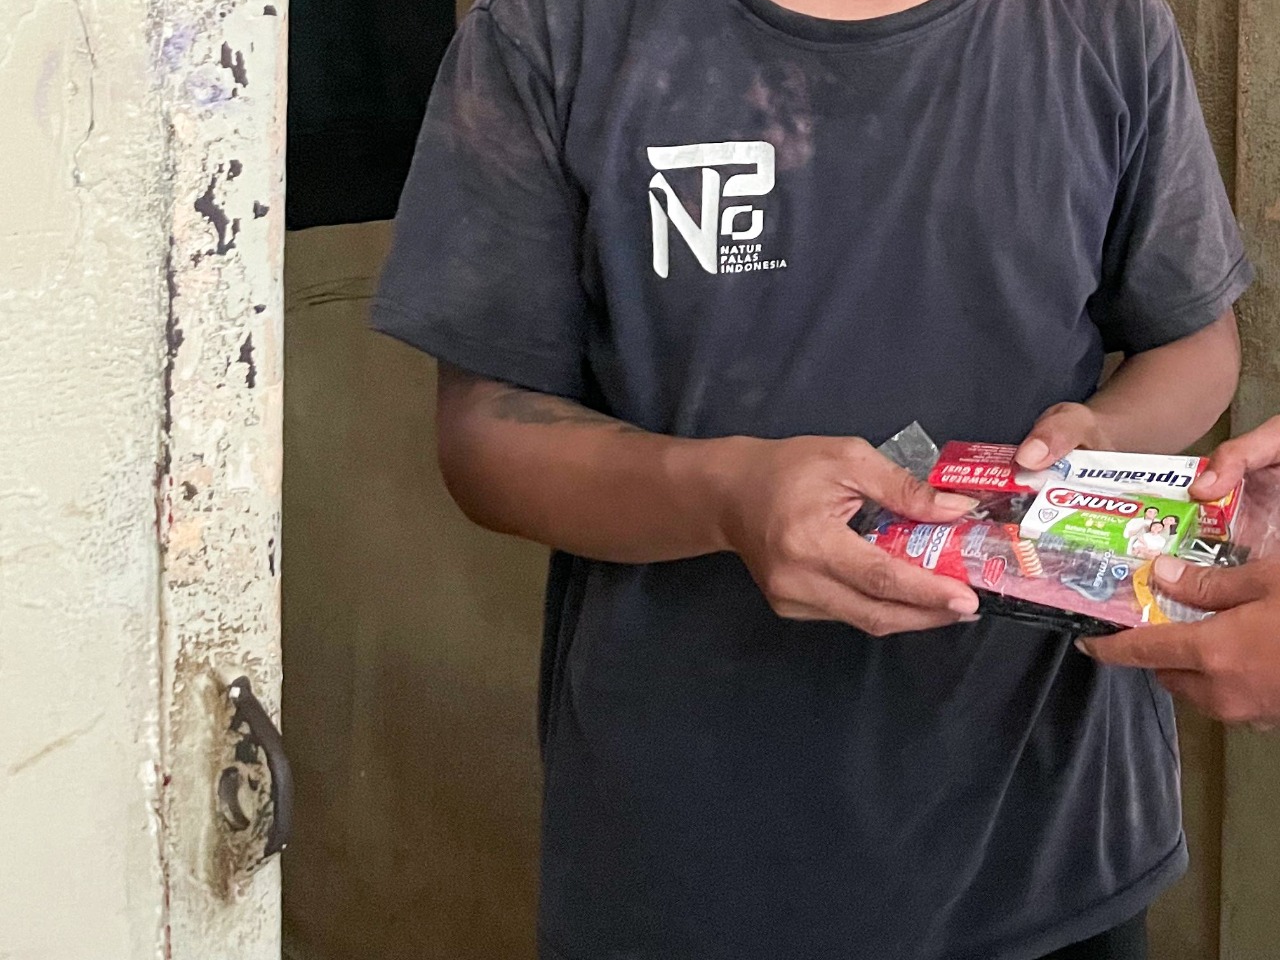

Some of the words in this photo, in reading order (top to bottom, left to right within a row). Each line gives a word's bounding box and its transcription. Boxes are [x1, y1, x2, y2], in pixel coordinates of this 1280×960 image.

[720, 244, 762, 254] NATUR
[720, 254, 759, 264] PALAS
[720, 260, 787, 273] INDONESIA
[941, 474, 1009, 487] Perawatan
[1076, 468, 1192, 487] Ciptadent
[1071, 494, 1139, 514] NUVO
